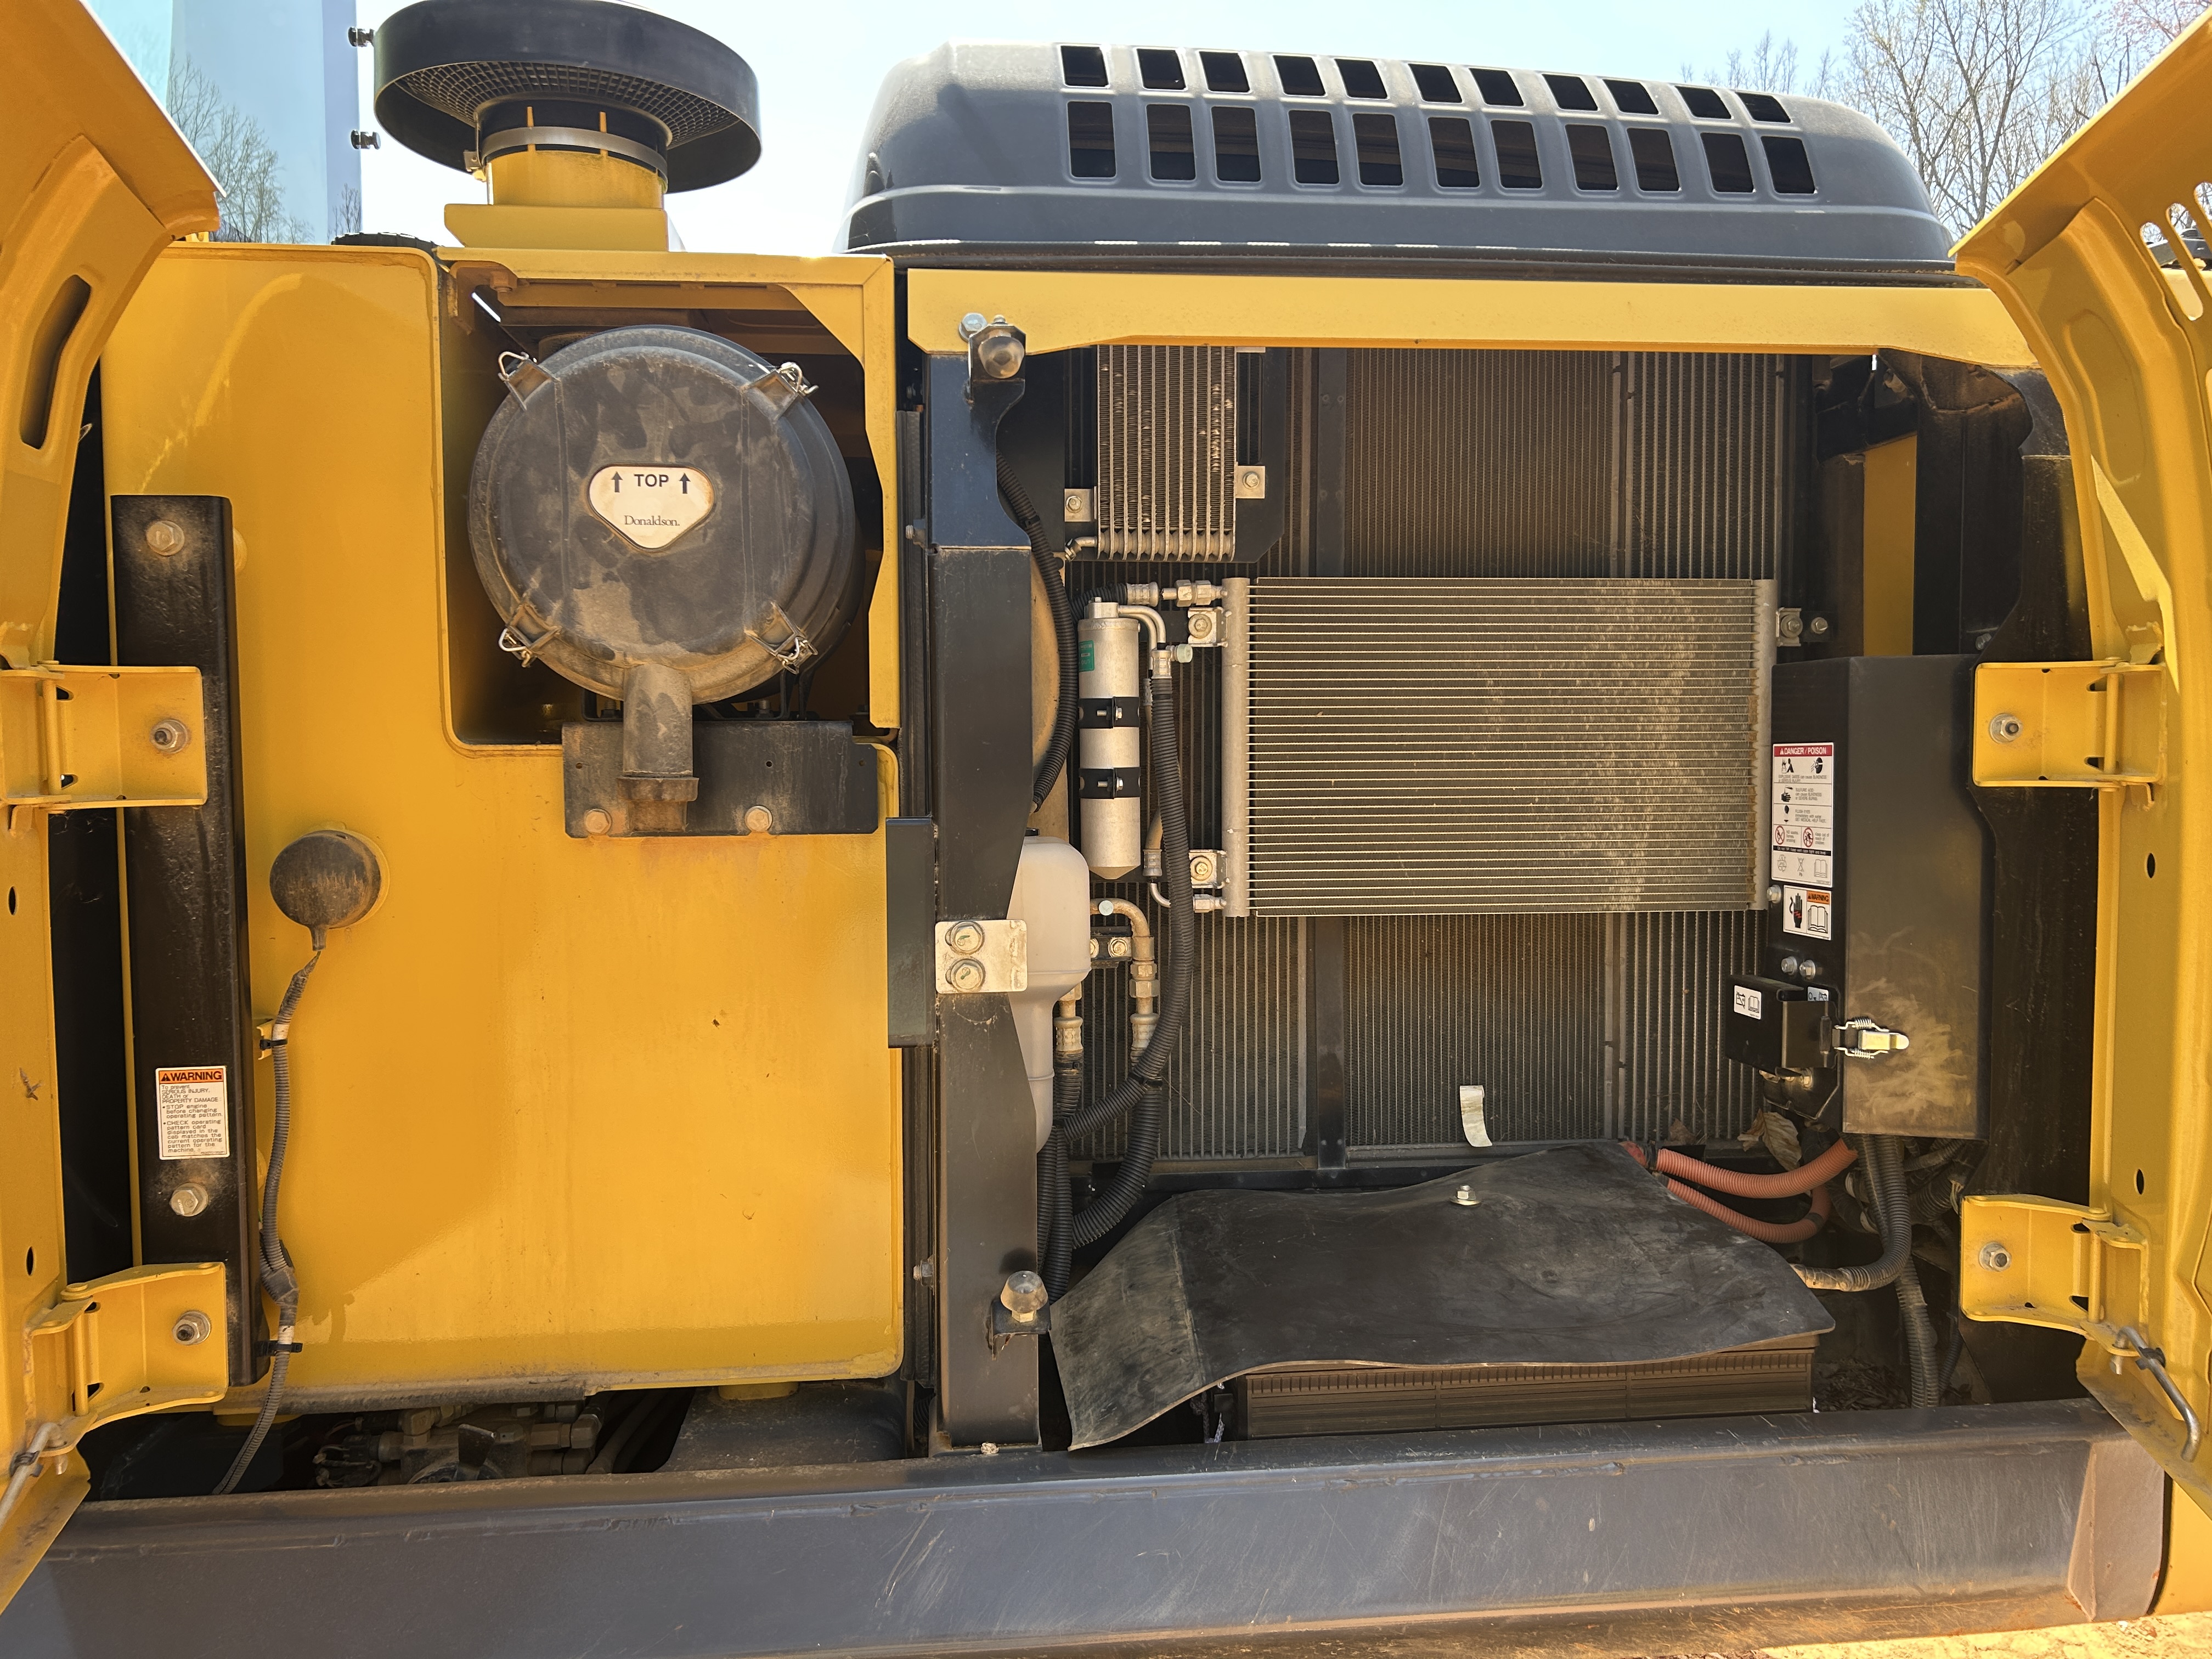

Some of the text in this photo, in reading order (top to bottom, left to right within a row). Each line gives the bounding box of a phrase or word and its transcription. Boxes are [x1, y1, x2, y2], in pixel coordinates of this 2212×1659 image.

[634, 474, 669, 487] TOP
[1812, 894, 1829, 902] WARNING
[170, 1071, 222, 1081] WARNING
